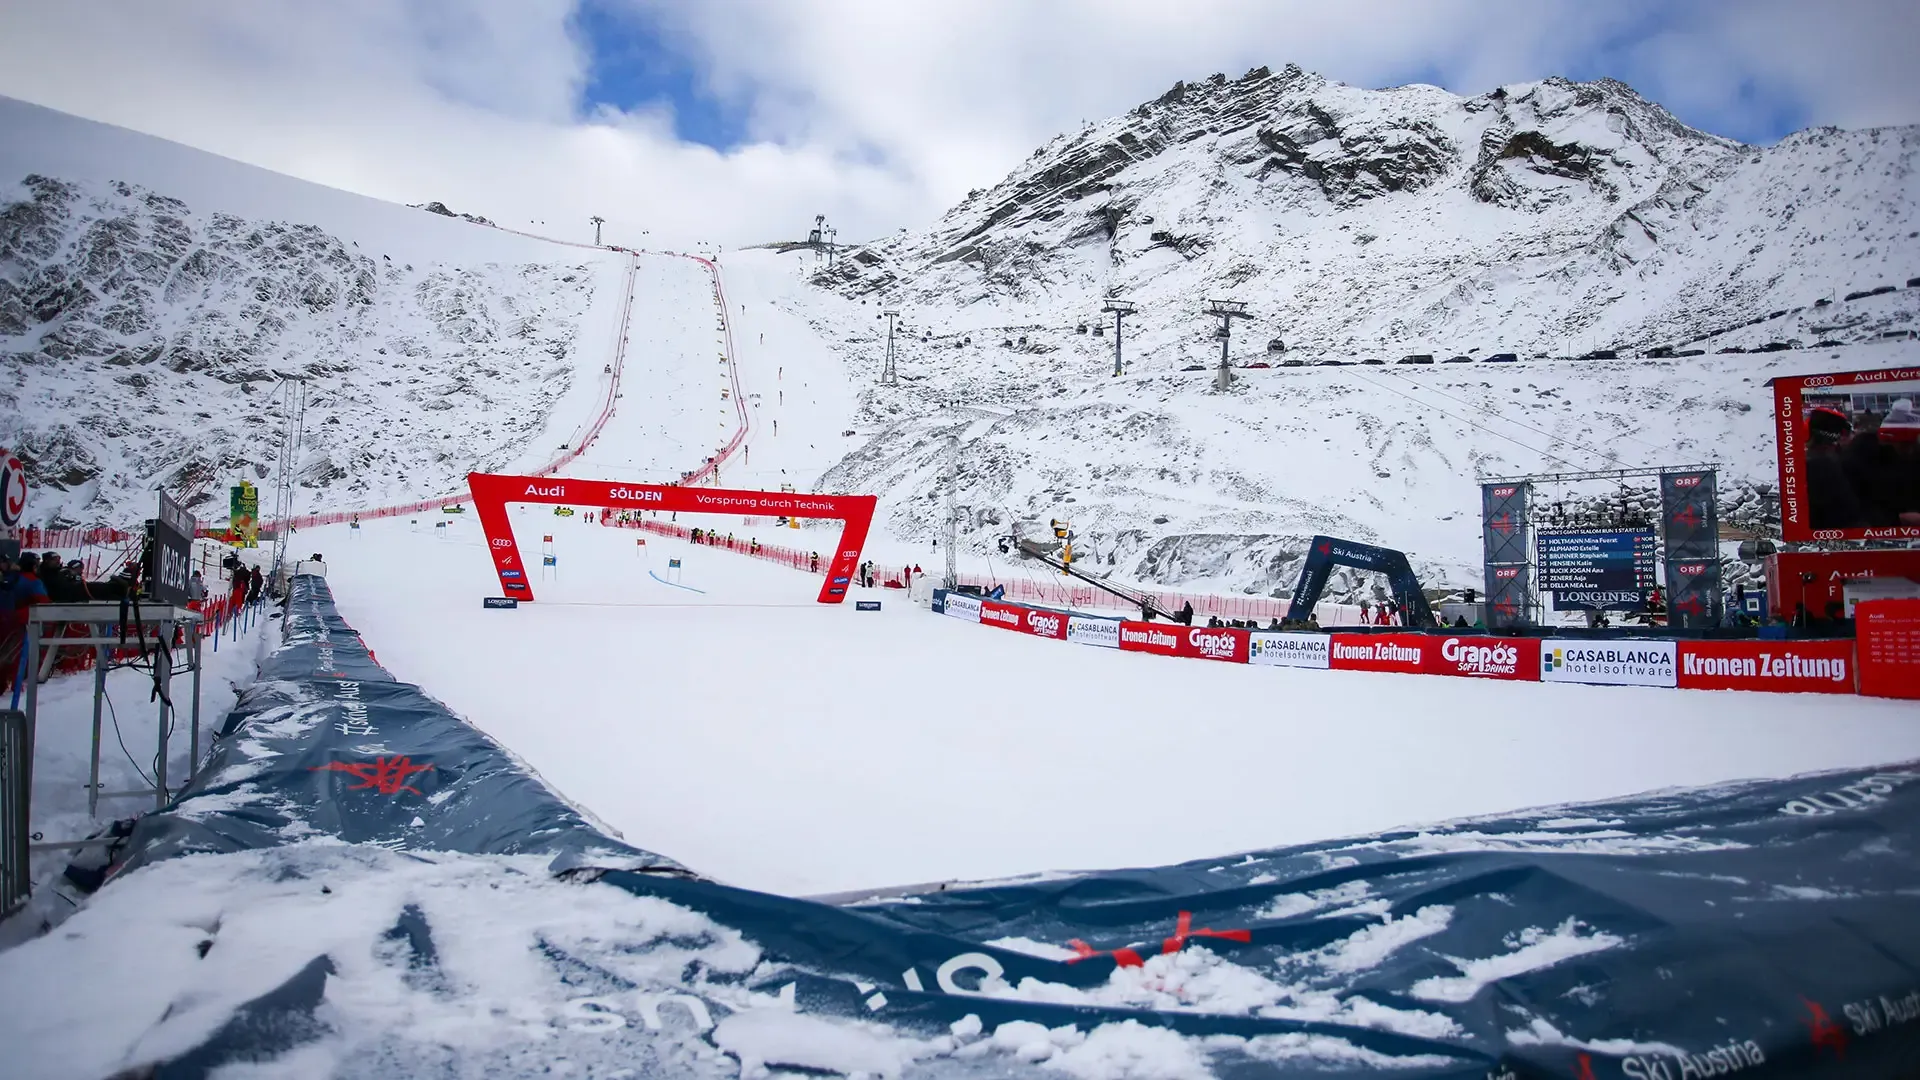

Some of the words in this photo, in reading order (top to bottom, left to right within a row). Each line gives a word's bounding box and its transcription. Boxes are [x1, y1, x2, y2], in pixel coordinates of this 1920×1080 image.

[1854, 372, 1886, 382] Audi
[1782, 396, 1792, 418] Cup
[1784, 420, 1794, 455] World
[1786, 457, 1795, 474] Ski
[1494, 488, 1514, 496] ORF
[1787, 476, 1796, 495] FIS
[524, 484, 565, 496] Audi
[610, 488, 662, 501] SÖLDEN
[696, 494, 757, 508] Vorsprung
[760, 498, 792, 508] durch
[794, 500, 834, 510] Technik
[1788, 498, 1798, 522] Audi
[1864, 528, 1896, 536] Audi
[1332, 548, 1345, 556] Ski
[1345, 550, 1372, 562] Austria
[1580, 552, 1608, 560] Stephanie
[1558, 591, 1640, 602] LONGINES
[951, 599, 980, 612] CASABLANCA
[981, 606, 1000, 620] Kronen
[1000, 609, 1020, 626] Zeitung
[1076, 622, 1117, 634] CASABLANCA
[1122, 628, 1148, 644] Kronen
[1148, 630, 1177, 649] Zeitung
[1264, 640, 1326, 652] CASABLANCA
[1264, 650, 1327, 661] hotelsoftware
[1333, 642, 1373, 660] Kronen
[1374, 642, 1421, 664] Zeitung
[1566, 650, 1670, 664] CASABLANCA
[1457, 662, 1478, 672] SOFT
[1483, 664, 1515, 674] DRINKS
[1566, 662, 1672, 677] hotelsoftware
[1684, 653, 1756, 677] Kronen
[1760, 653, 1845, 681] Zeitung
[1843, 999, 1881, 1036] Ski
[1879, 989, 1920, 1028] Aust
[1676, 1037, 1765, 1080] Austria
